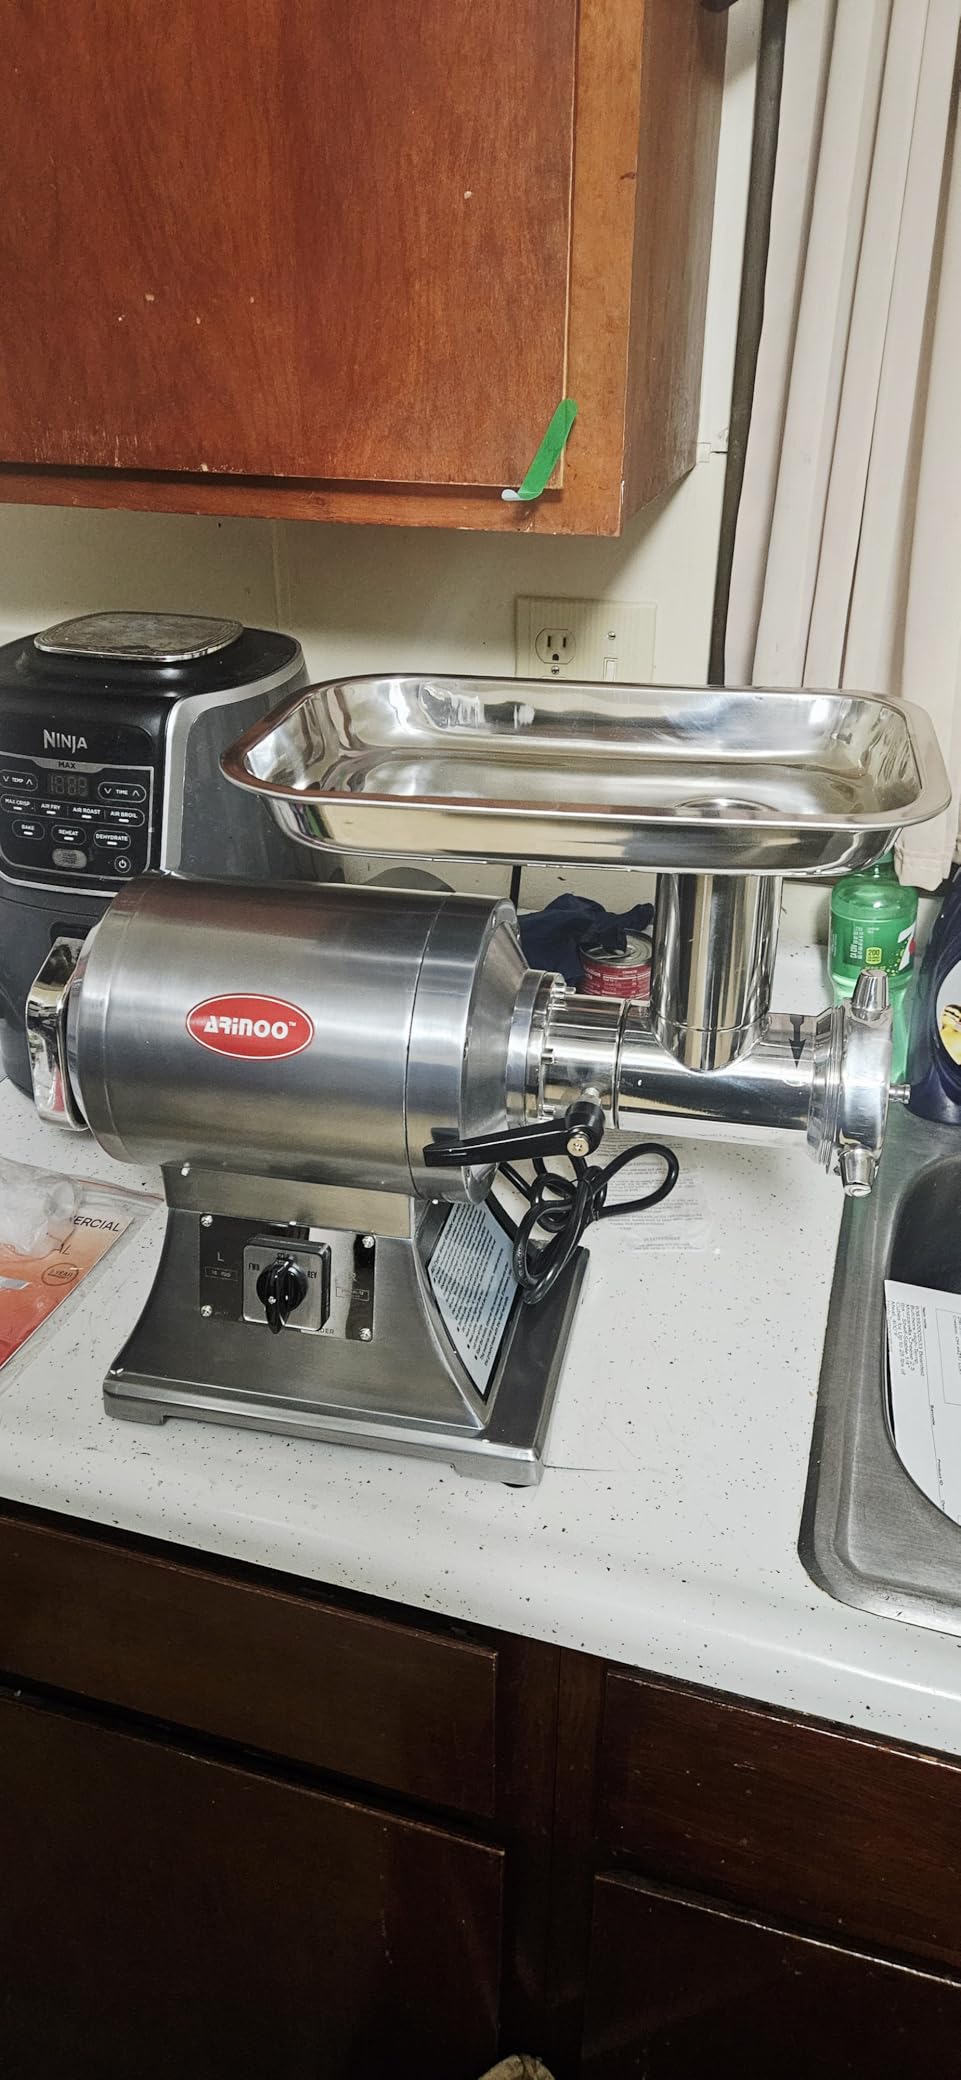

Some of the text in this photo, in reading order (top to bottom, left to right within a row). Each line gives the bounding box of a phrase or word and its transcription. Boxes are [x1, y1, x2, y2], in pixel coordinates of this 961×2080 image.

[44, 729, 88, 754] NINJA
[58, 761, 77, 769] MAX
[96, 834, 128, 842] DEHYDRATE
[74, 1216, 120, 1232] ERCIAL
[248, 1262, 260, 1271] FWD
[307, 1270, 317, 1279] REV
